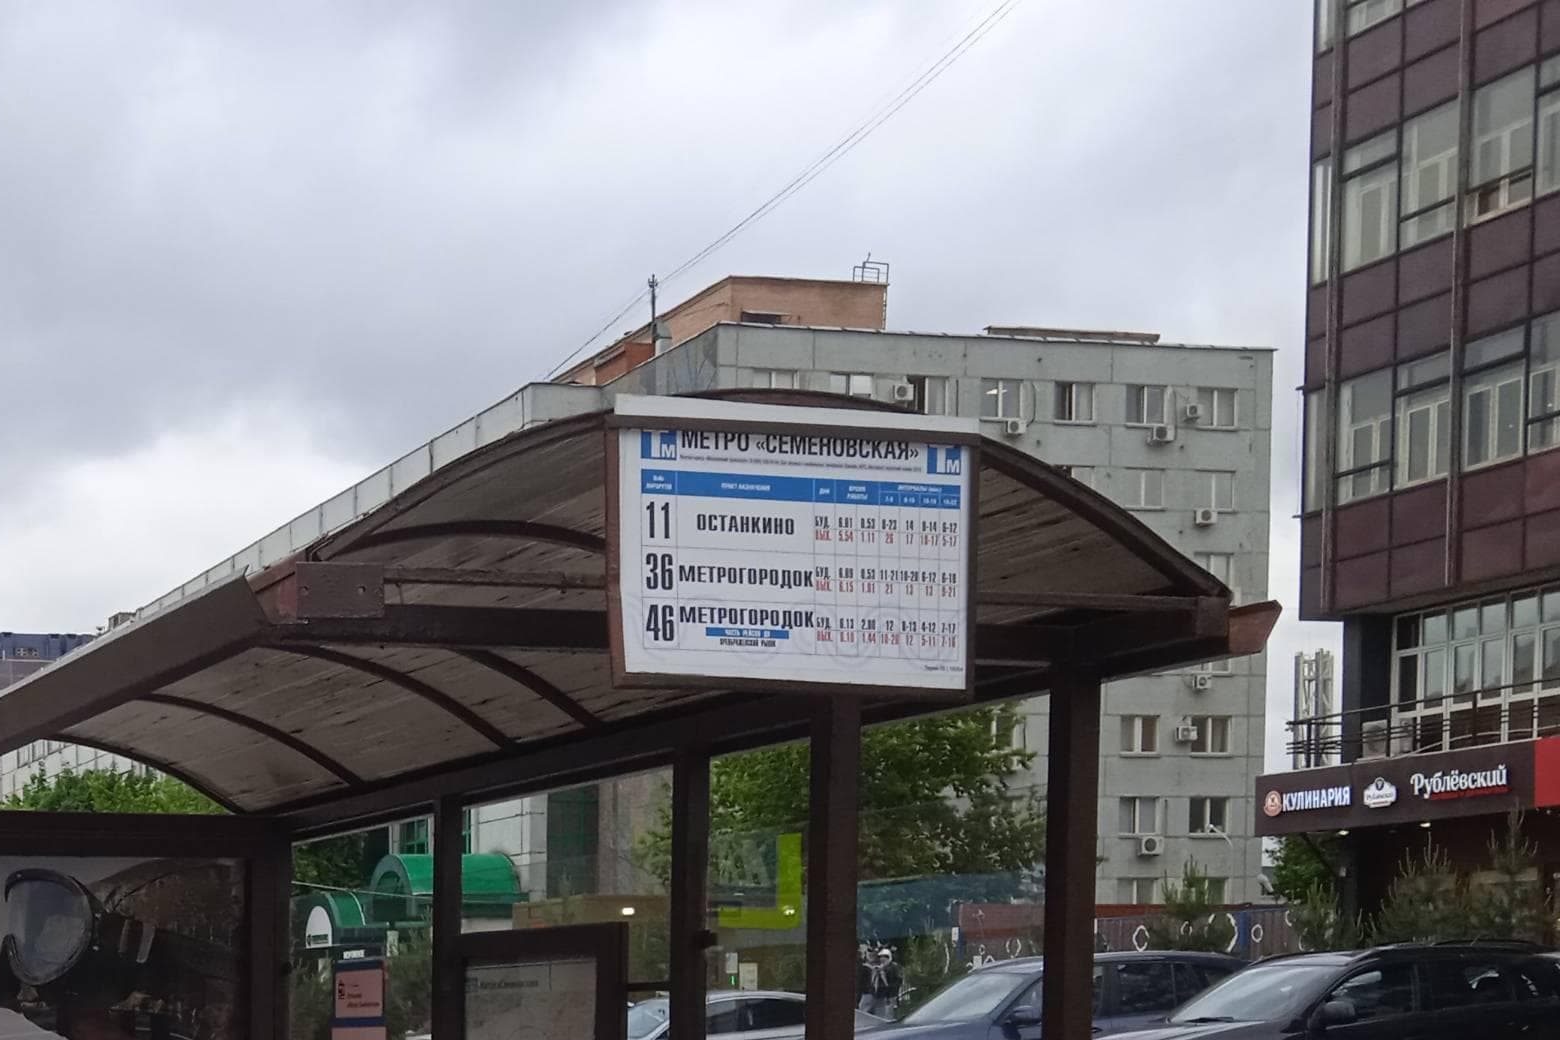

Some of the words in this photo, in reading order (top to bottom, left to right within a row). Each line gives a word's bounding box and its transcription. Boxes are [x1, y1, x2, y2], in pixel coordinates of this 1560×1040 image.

[681, 430, 750, 451] МЕТРО
[646, 501, 670, 538] 11
[696, 513, 795, 535] ОСТАНКИНО
[646, 553, 673, 590] 36
[679, 565, 813, 589] МЕТРОГОРОДОК
[646, 604, 674, 641] 46
[679, 606, 814, 629] МЕТРОГОРОДОК
[1410, 764, 1507, 799] Рублёвский
[1282, 786, 1351, 813] КУЛИНАРИЯ
